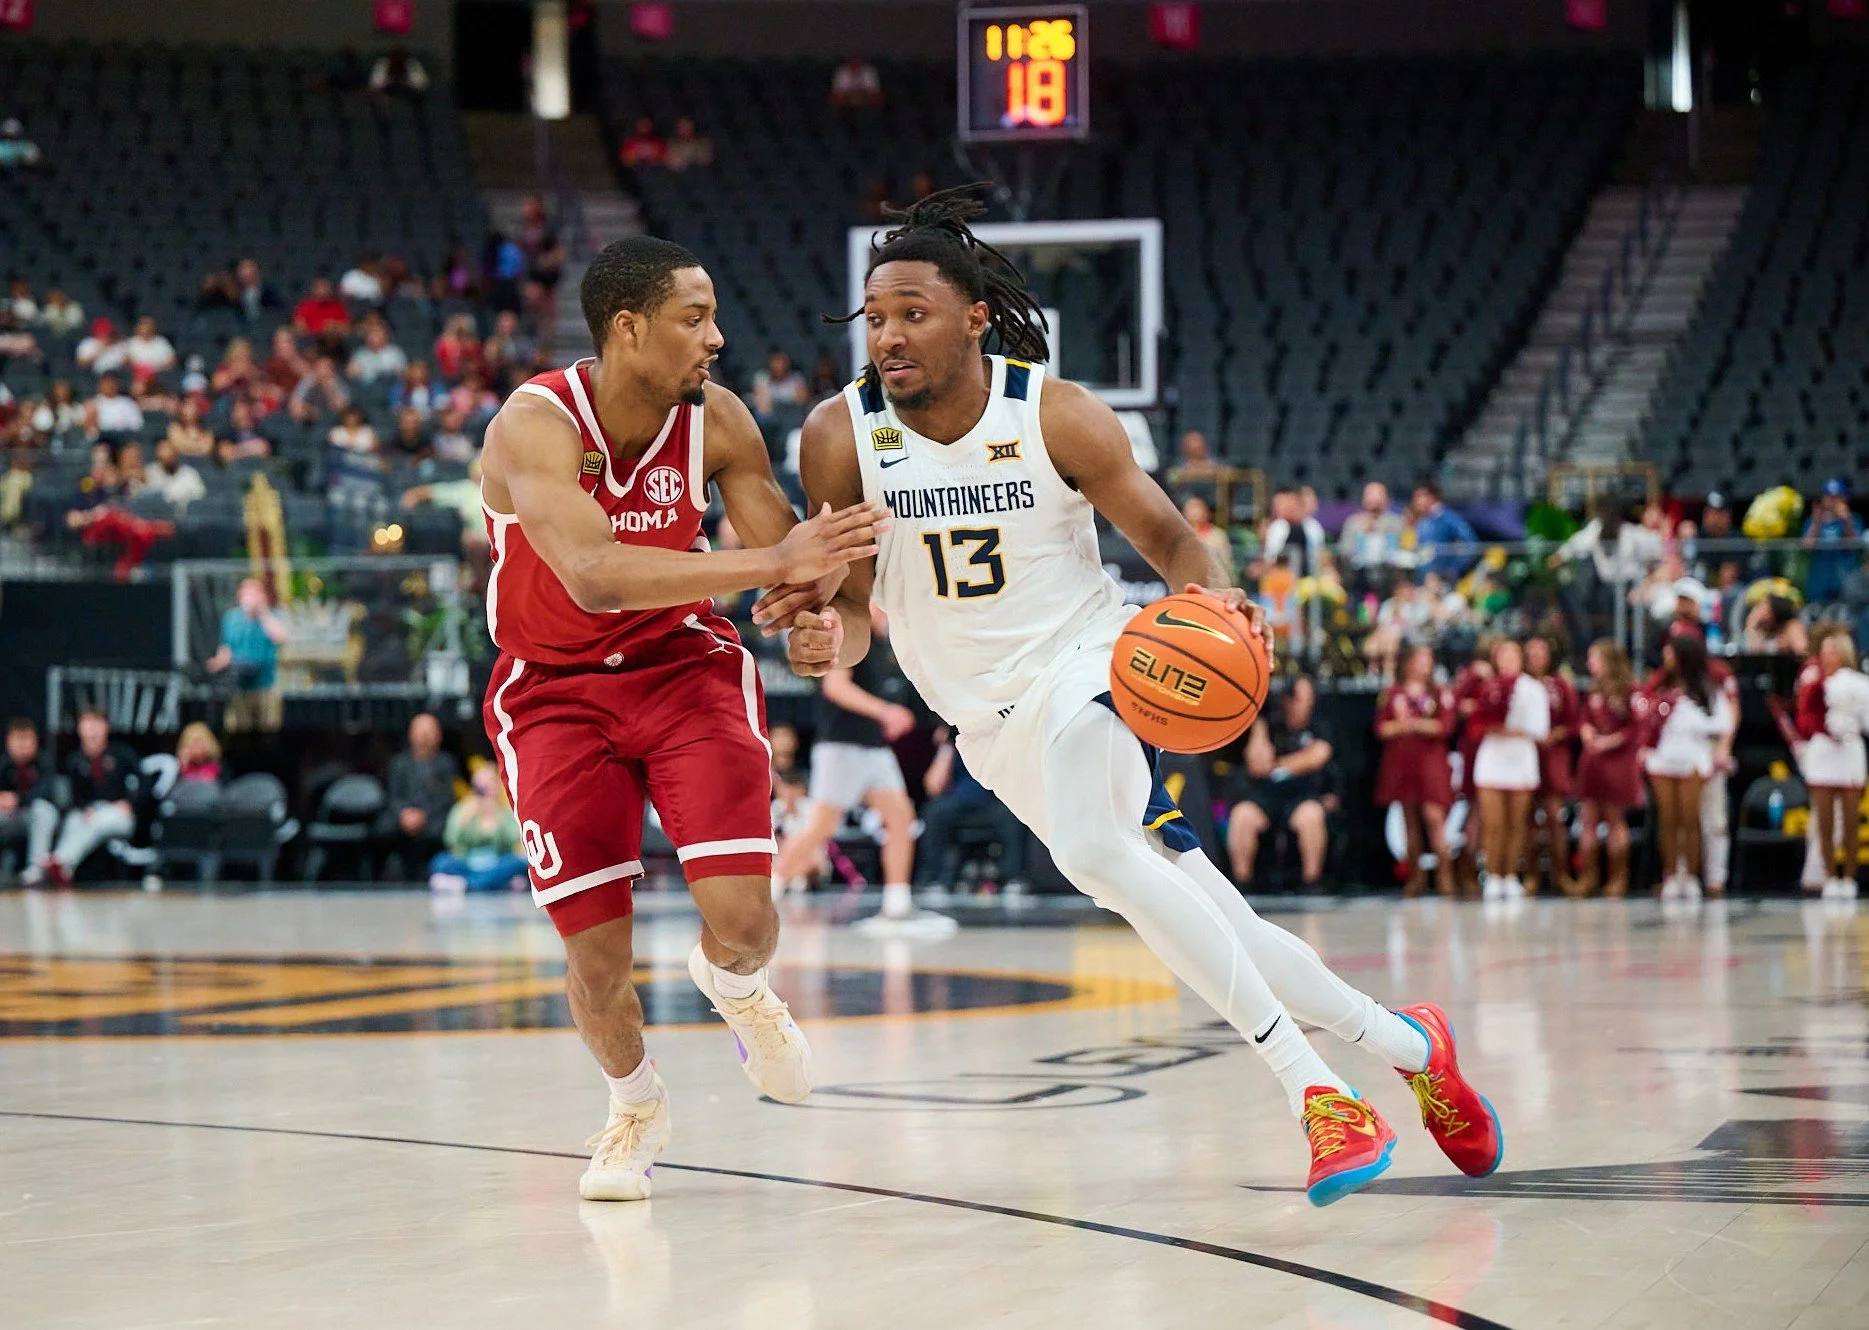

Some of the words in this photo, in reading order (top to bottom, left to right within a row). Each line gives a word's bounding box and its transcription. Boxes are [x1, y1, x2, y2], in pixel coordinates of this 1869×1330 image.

[1007, 61, 1067, 126] 18
[987, 441, 1021, 462] XII
[647, 468, 681, 502] SEC
[883, 480, 1035, 519] MOUNTAINEERS
[610, 507, 679, 533] HOMA
[922, 527, 1007, 599] 13
[1129, 647, 1208, 700] ELITE
[523, 820, 563, 880] OU
